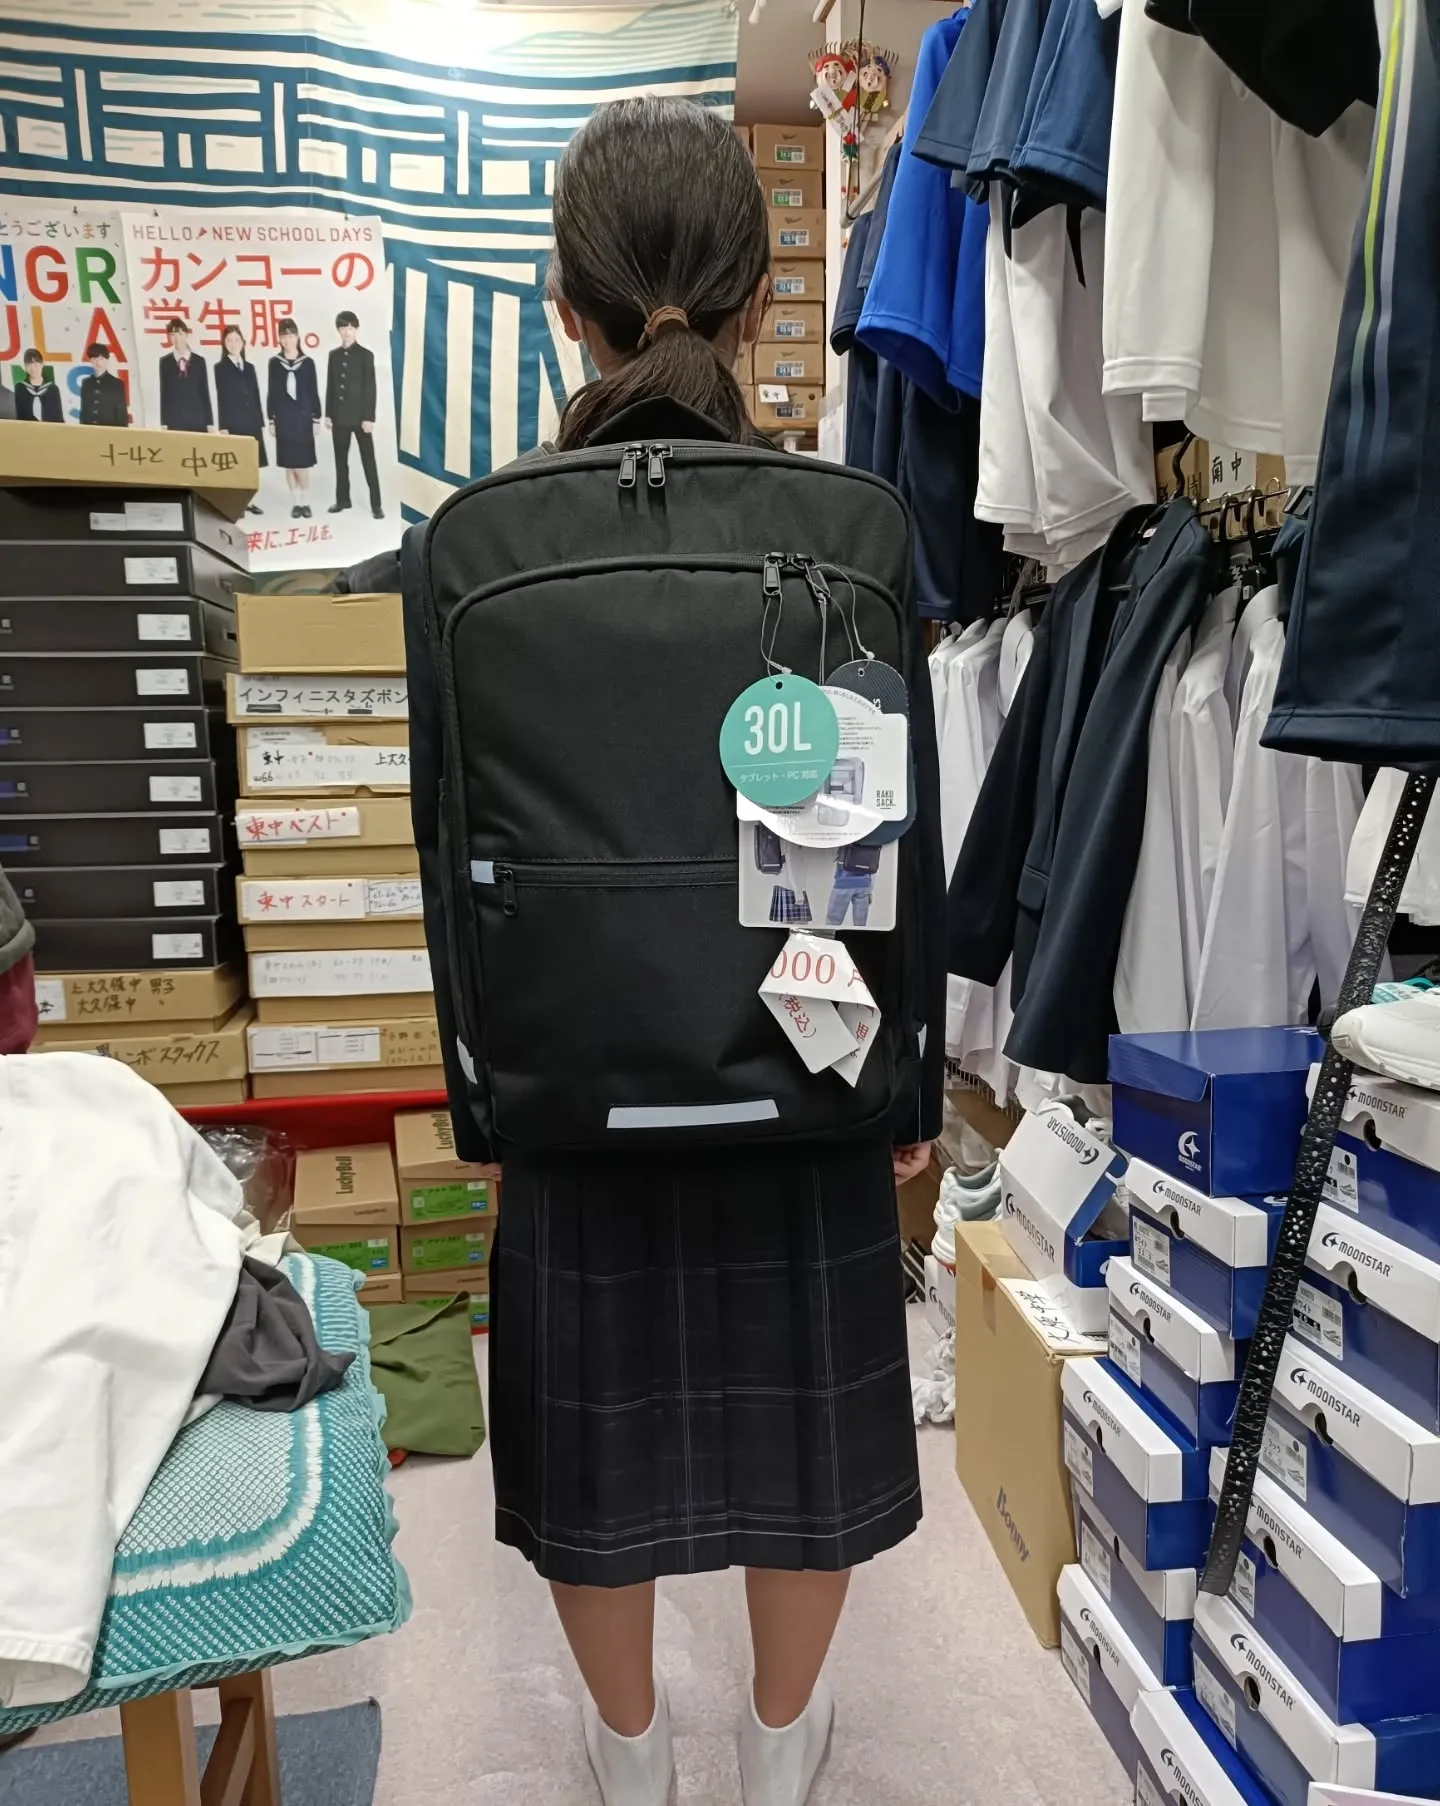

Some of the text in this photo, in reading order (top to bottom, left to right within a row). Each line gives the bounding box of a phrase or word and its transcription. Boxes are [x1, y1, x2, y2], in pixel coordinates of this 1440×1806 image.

[132, 225, 373, 243] HELLO NEW SCHOOL DAYS
[140, 246, 375, 292] カンコーの
[143, 298, 320, 349] 学生服。
[99, 443, 164, 467] スカート
[744, 701, 812, 756] 30L
[1357, 1091, 1407, 1119] MOONSTAR
[431, 1113, 455, 1151] LuckyBell
[1047, 1115, 1086, 1152] MOONSTAR
[336, 1156, 357, 1195] LuckyBell
[1165, 1186, 1203, 1217] MOONSTAR
[1016, 1208, 1056, 1263] MOONSTAR
[1337, 1240, 1392, 1277] MOONSTAR
[1139, 1289, 1173, 1323] MOONSTAR
[1092, 1400, 1122, 1438] MOONSTAR
[1307, 1379, 1362, 1429] MOONSTAR
[1256, 1504, 1303, 1556] MOONSTAR
[1089, 1619, 1121, 1667] MOONSTAR
[1245, 1650, 1294, 1711] MOONSTAR
